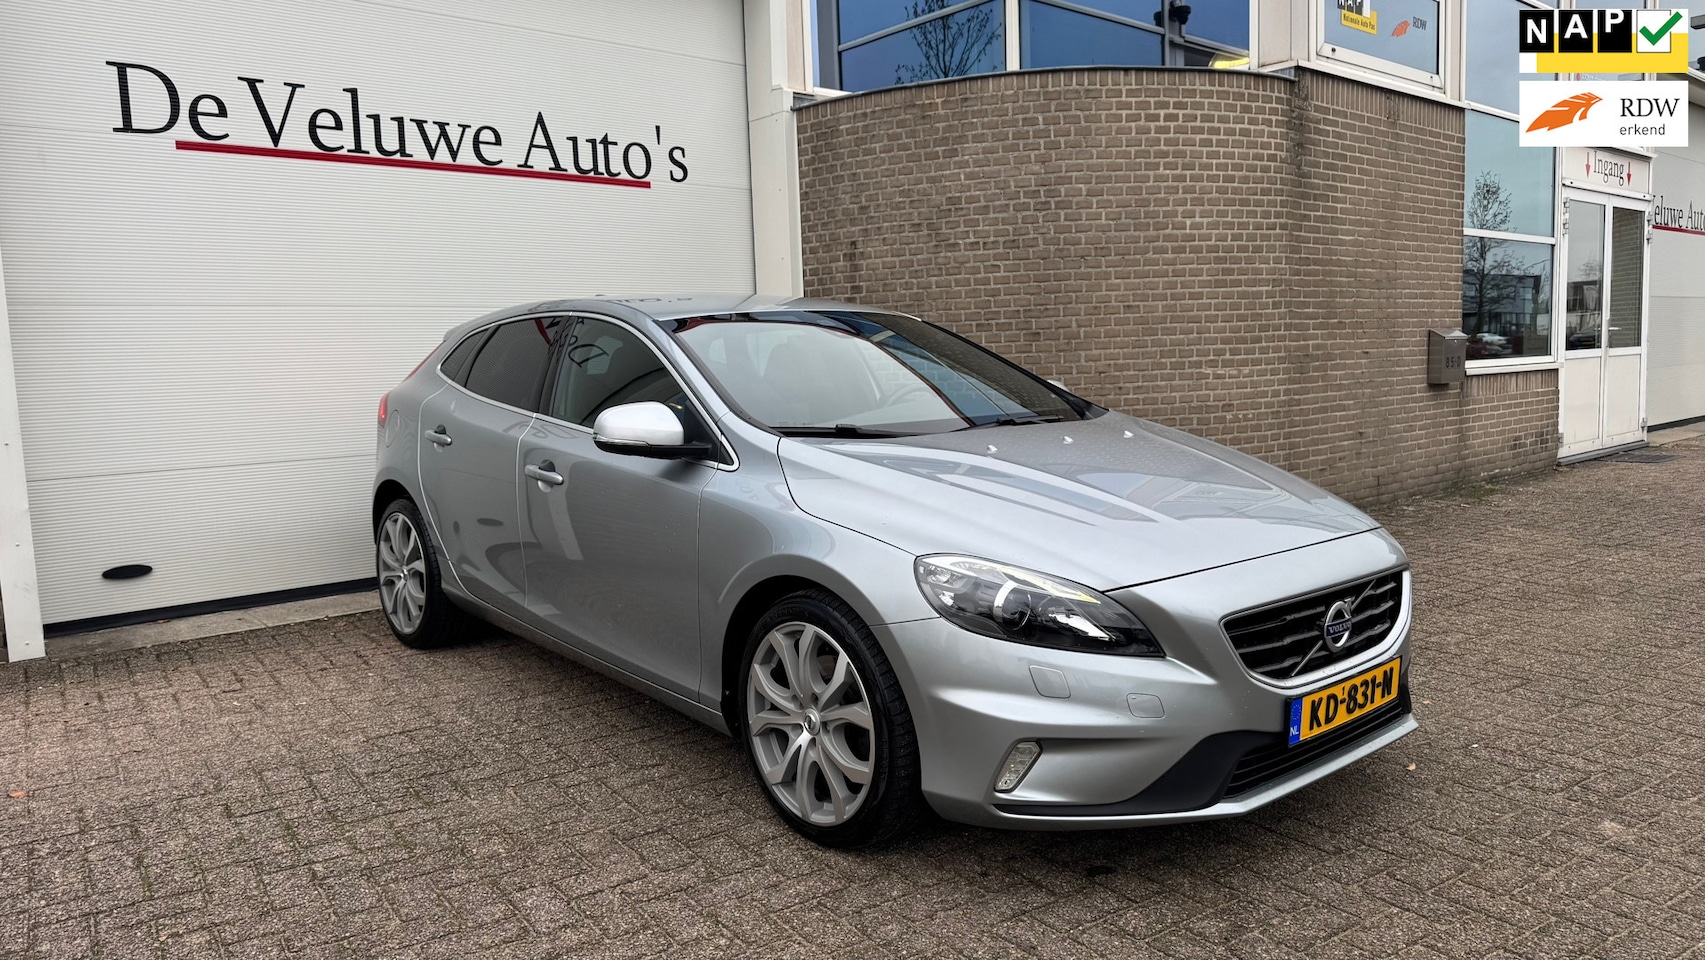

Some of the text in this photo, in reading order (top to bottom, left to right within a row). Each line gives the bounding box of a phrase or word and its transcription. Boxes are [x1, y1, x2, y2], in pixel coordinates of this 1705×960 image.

[1412, 16, 1427, 31] RDW
[106, 60, 689, 183] De Veluwe Auto's
[1593, 150, 1625, 187] Ingang
[1653, 194, 1684, 229] eluwe
[1328, 620, 1351, 634] VOLVO
[1290, 666, 1394, 737] NL KD-831-N
